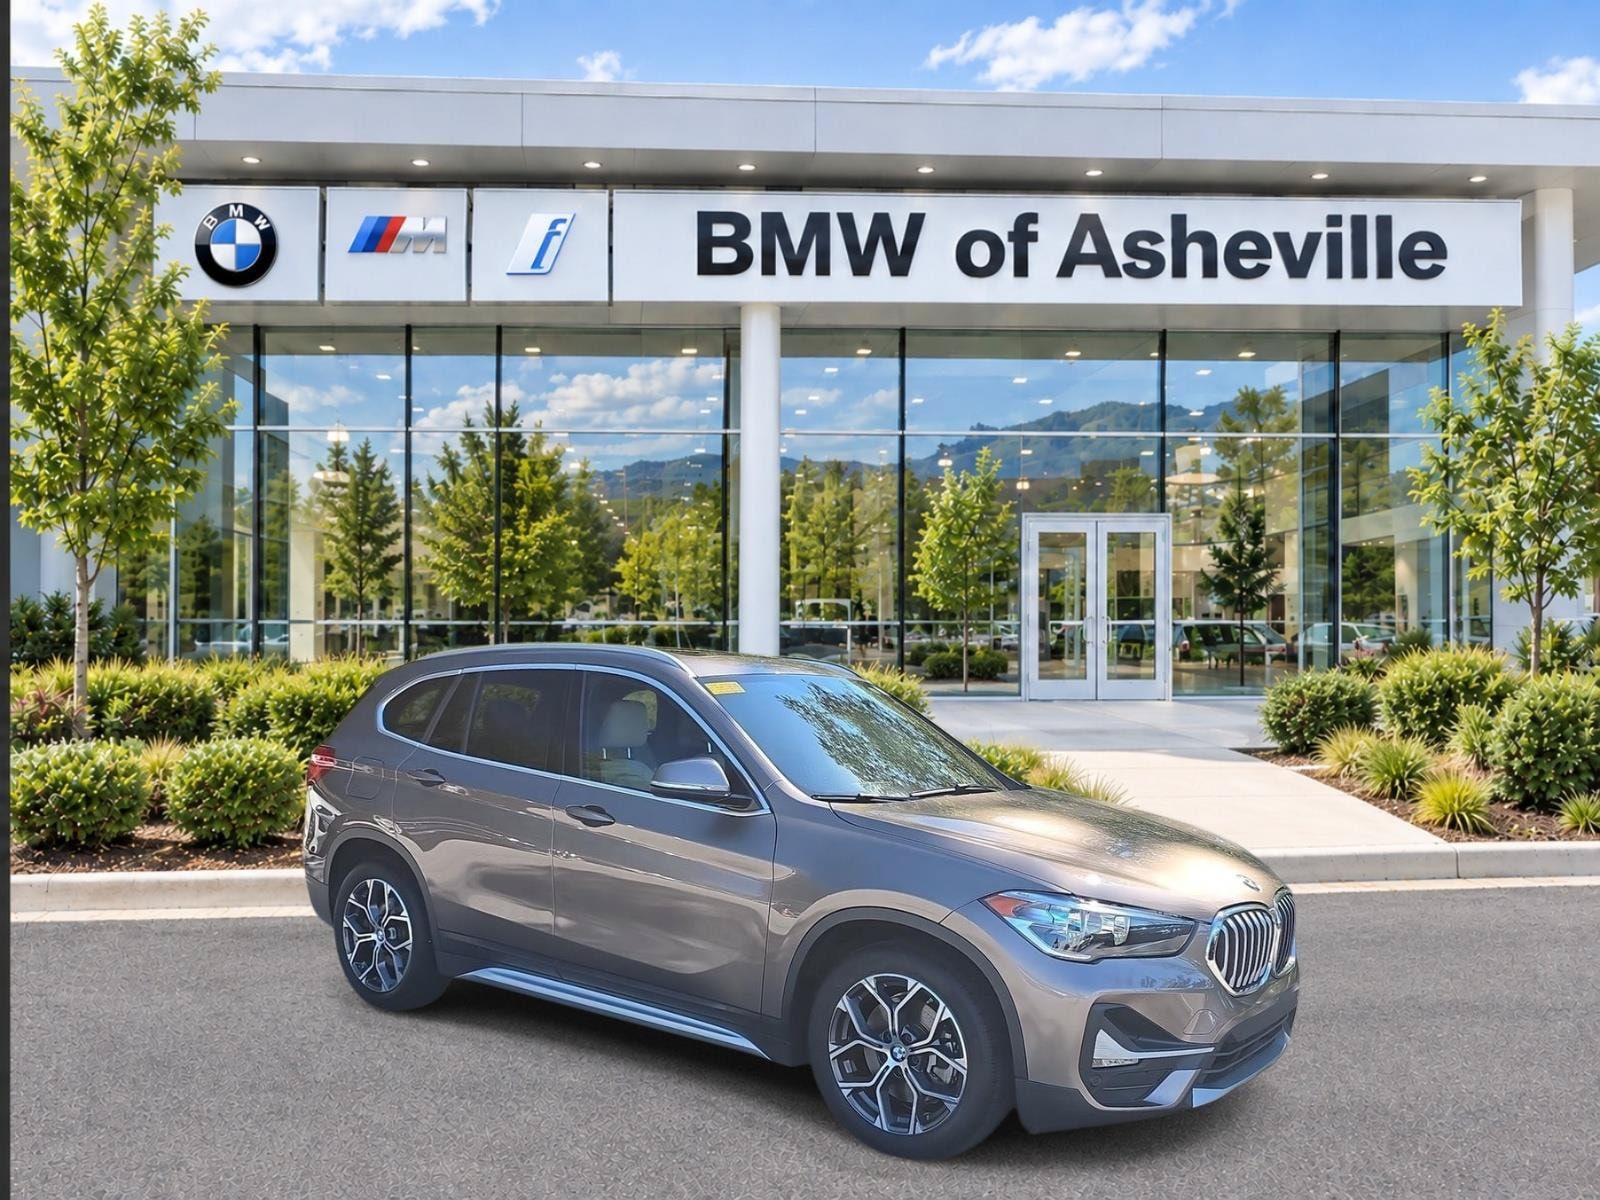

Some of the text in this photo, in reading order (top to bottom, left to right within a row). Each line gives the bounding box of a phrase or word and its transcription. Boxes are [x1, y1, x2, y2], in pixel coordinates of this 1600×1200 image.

[203, 204, 270, 231] BMW
[389, 216, 447, 254] M
[697, 210, 1448, 280] BMW of Asheville
